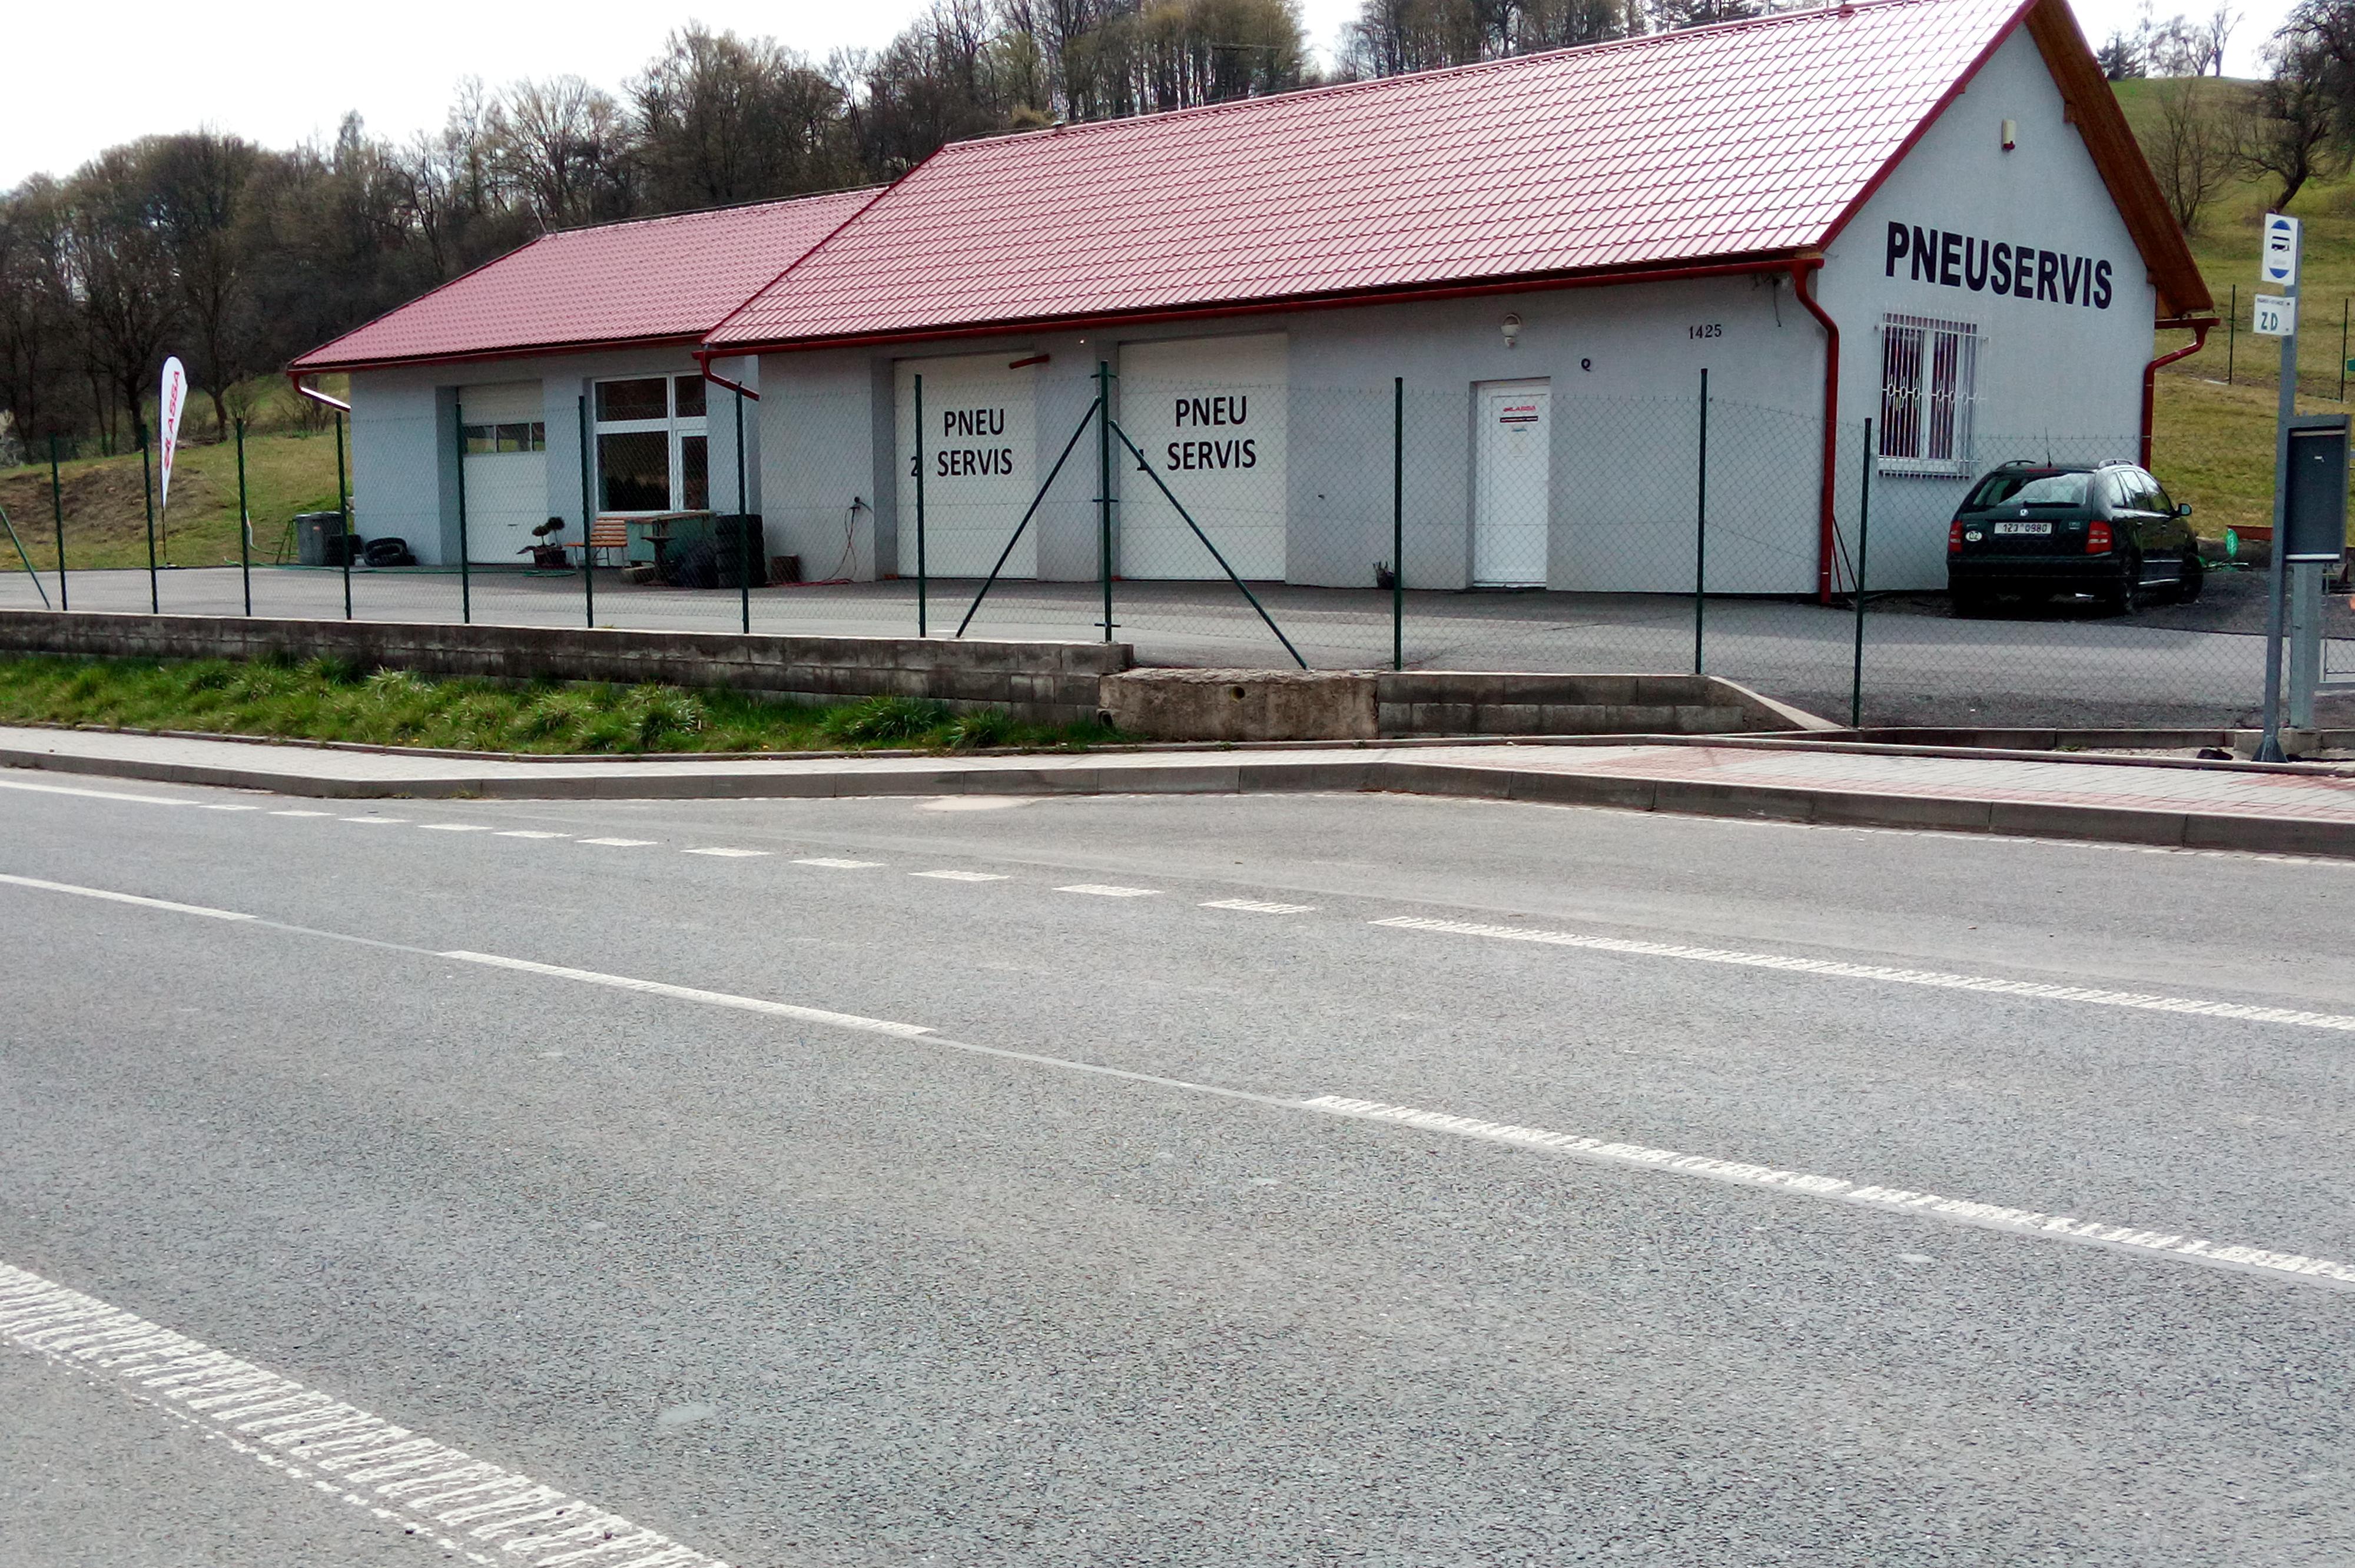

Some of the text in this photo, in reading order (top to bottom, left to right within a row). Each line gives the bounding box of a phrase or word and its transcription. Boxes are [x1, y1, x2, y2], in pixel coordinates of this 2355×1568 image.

[1886, 221, 2112, 310] PNEUSERVIS
[1689, 324, 1722, 339] 1425
[944, 408, 1004, 437] PNEU
[1176, 396, 1246, 427] PNEU
[937, 449, 1012, 477] SERVIS
[1167, 439, 1256, 471] SERVIS
